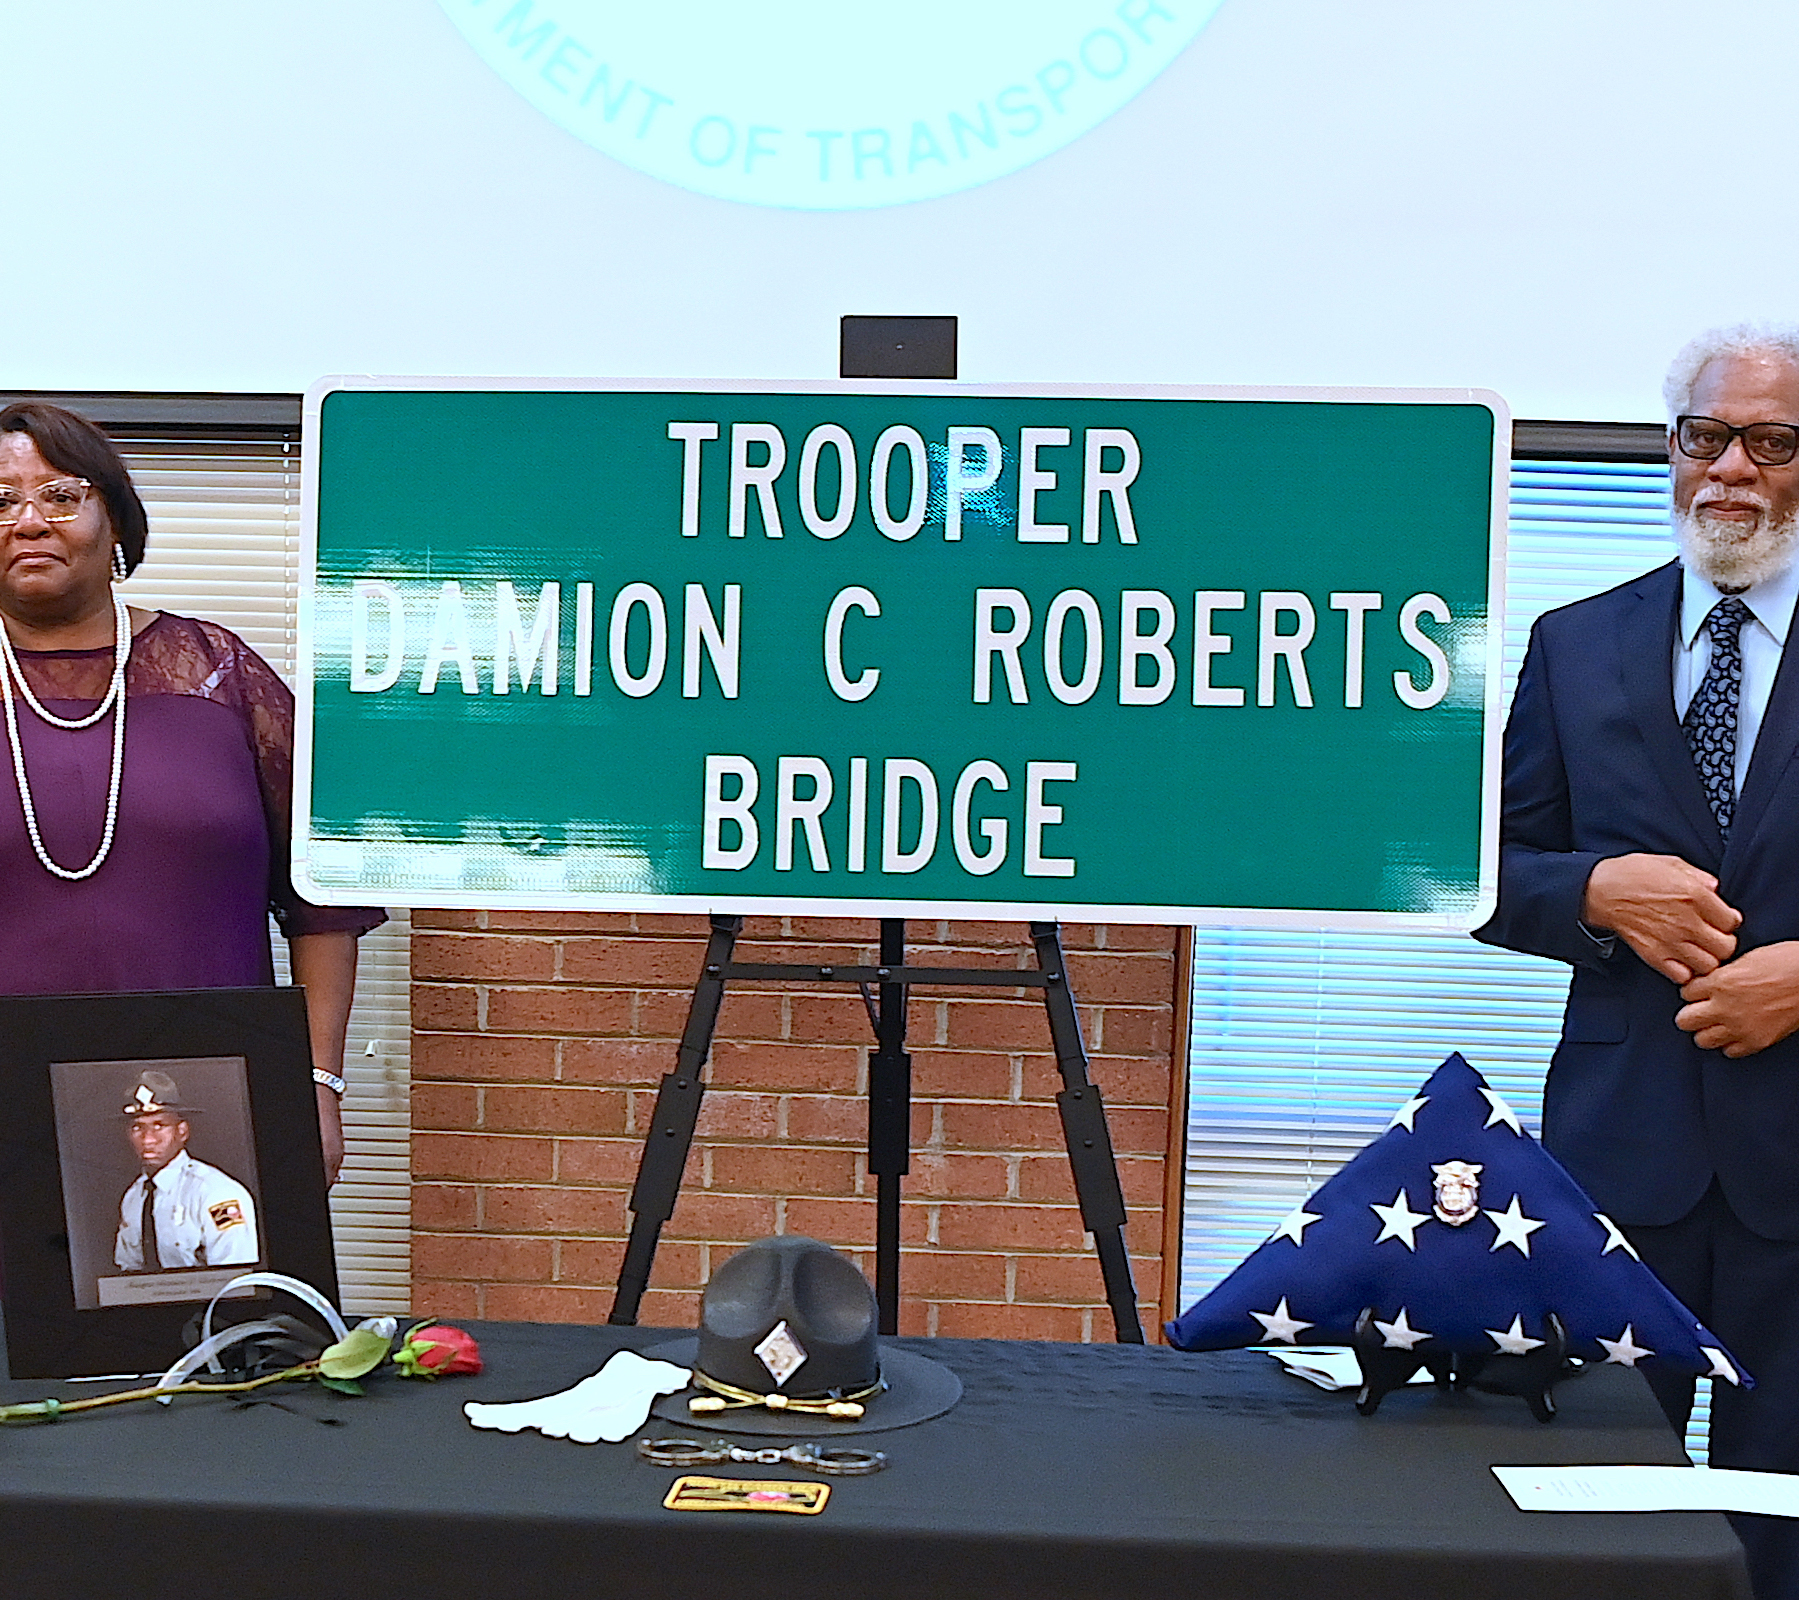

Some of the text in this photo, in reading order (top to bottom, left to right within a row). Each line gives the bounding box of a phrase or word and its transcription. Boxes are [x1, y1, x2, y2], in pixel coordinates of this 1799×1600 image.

[471, 0, 1176, 182] MENT OF TRANSPOR
[667, 420, 1141, 545] TROOPER
[350, 580, 1452, 710] DAMION C ROBERTS
[702, 754, 1077, 877] BRIDGE
